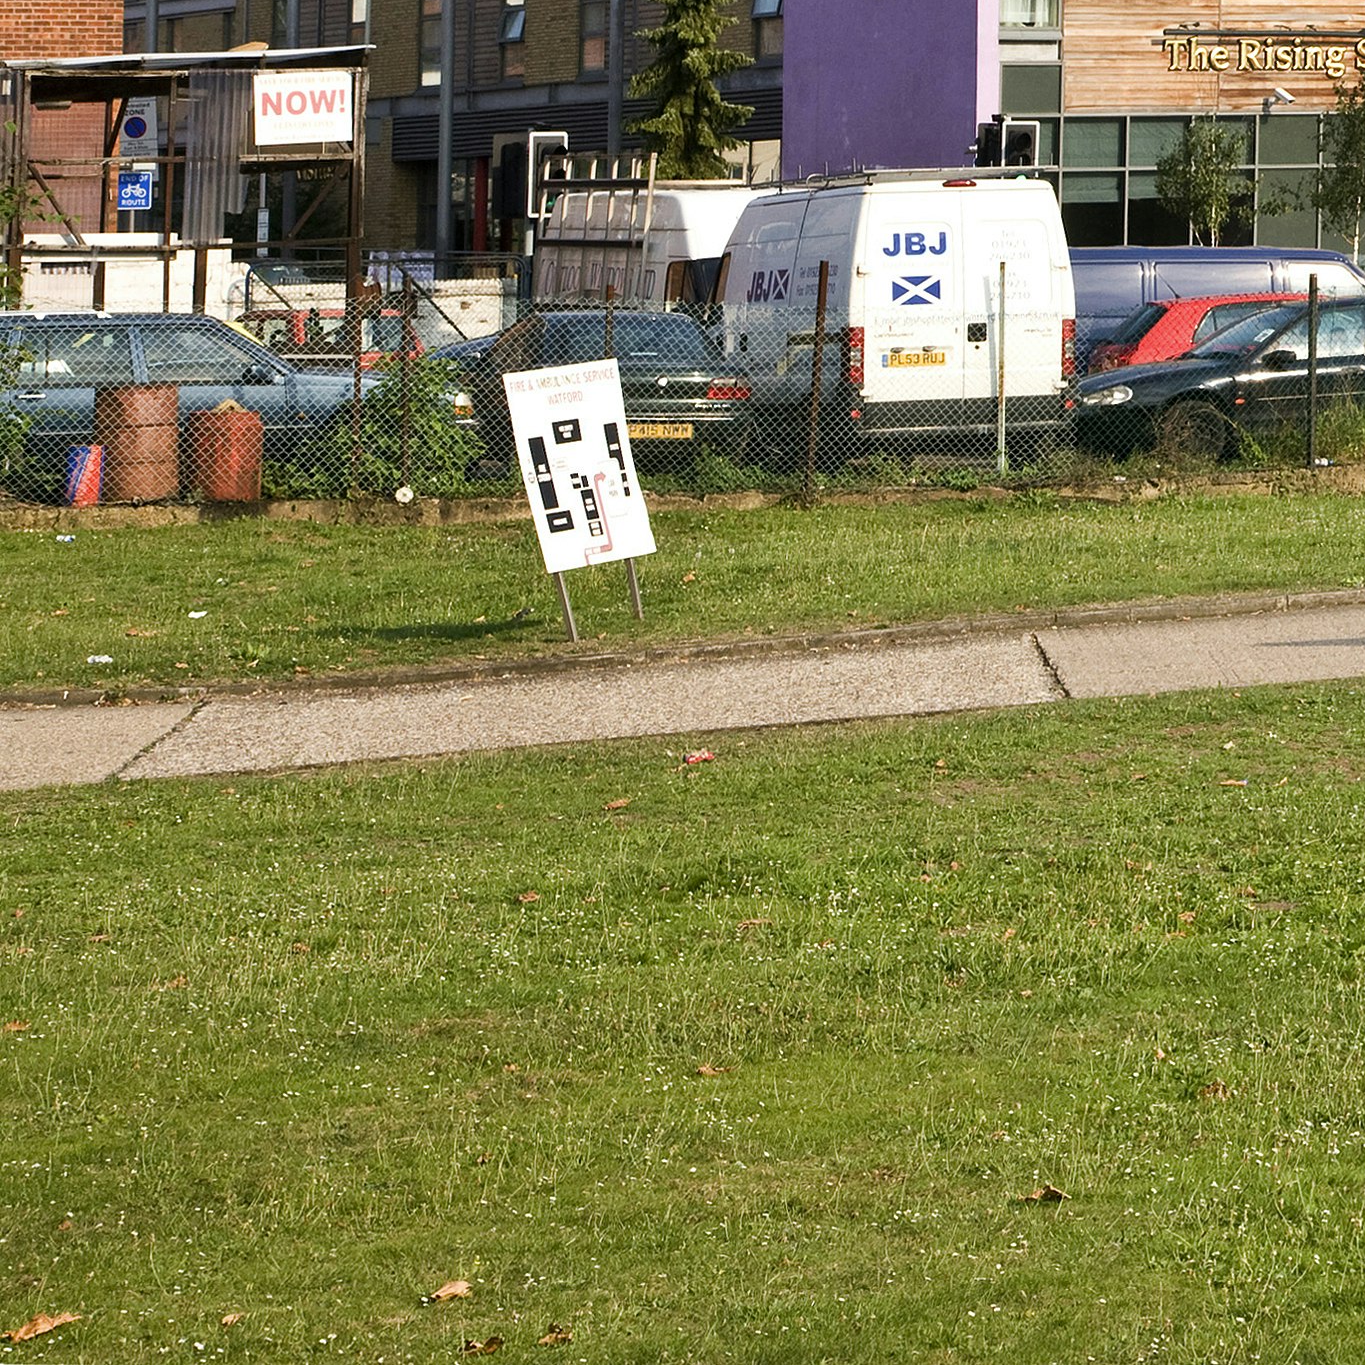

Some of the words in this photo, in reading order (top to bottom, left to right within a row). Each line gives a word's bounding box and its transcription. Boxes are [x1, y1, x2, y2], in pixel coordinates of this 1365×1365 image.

[1165, 36, 1230, 71] The
[1237, 37, 1347, 79] Rising
[261, 89, 345, 116] NOW!
[882, 232, 947, 257] JBJ
[747, 270, 773, 302] JBJ
[890, 354, 920, 365] PL53
[923, 352, 945, 364] RUJ
[582, 367, 615, 383] SERVICE
[547, 391, 583, 405] WATFORD
